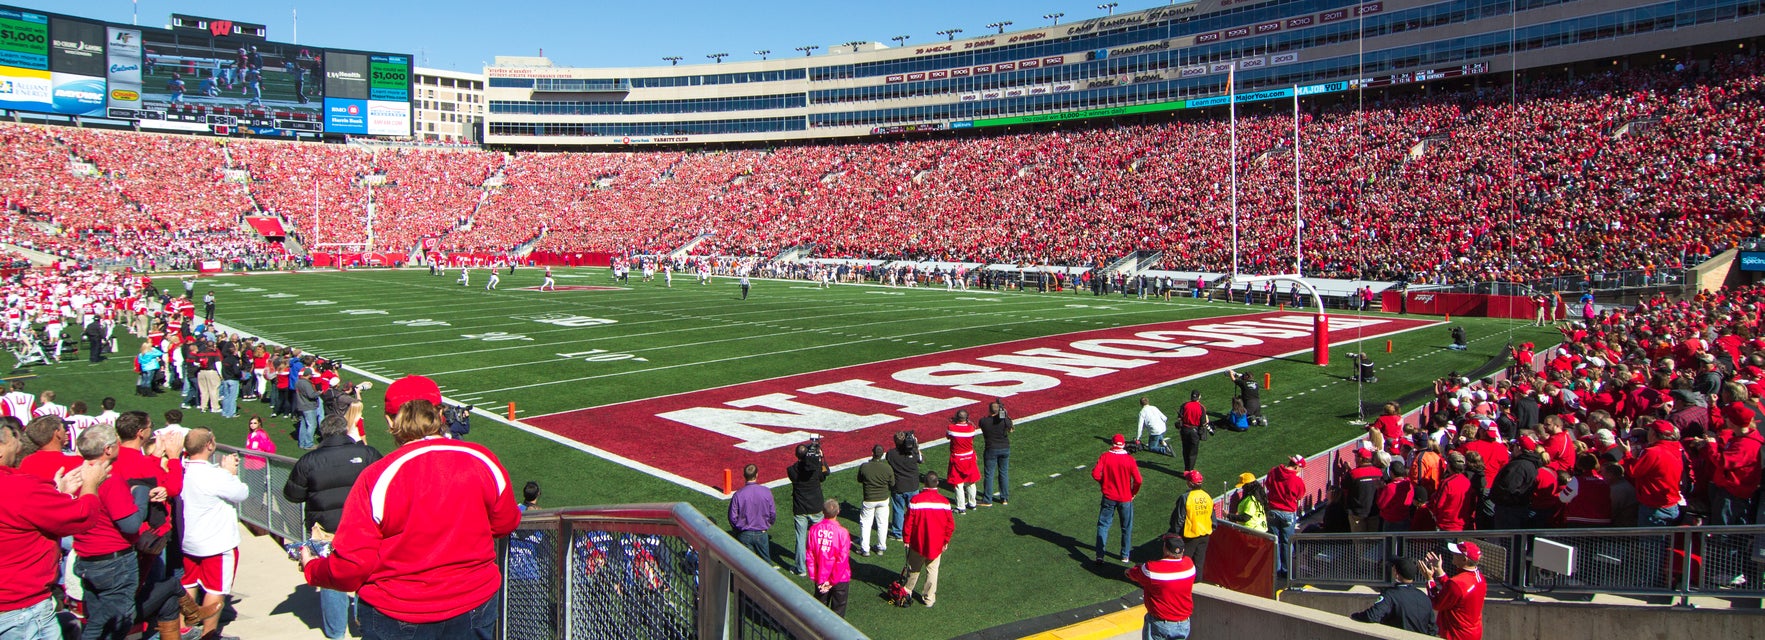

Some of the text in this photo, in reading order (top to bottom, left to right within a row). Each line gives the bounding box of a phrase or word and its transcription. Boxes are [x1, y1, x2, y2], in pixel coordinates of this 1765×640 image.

[1358, 5, 1378, 13] 2012
[1325, 12, 1342, 20] 2011
[1067, 6, 1194, 35] CAMP RANDALL STADIUM
[1290, 18, 1310, 26] 2010
[1, 29, 45, 43] $1,000
[1110, 41, 1170, 56] CHAMPIONS
[373, 72, 405, 80] $1,000
[1134, 74, 1163, 82] BOWL
[16, 82, 48, 91] ALLIANT
[1236, 90, 1285, 101] MajorYou.com
[654, 316, 1393, 452] WISCONSIN
[818, 530, 833, 538] CSC
